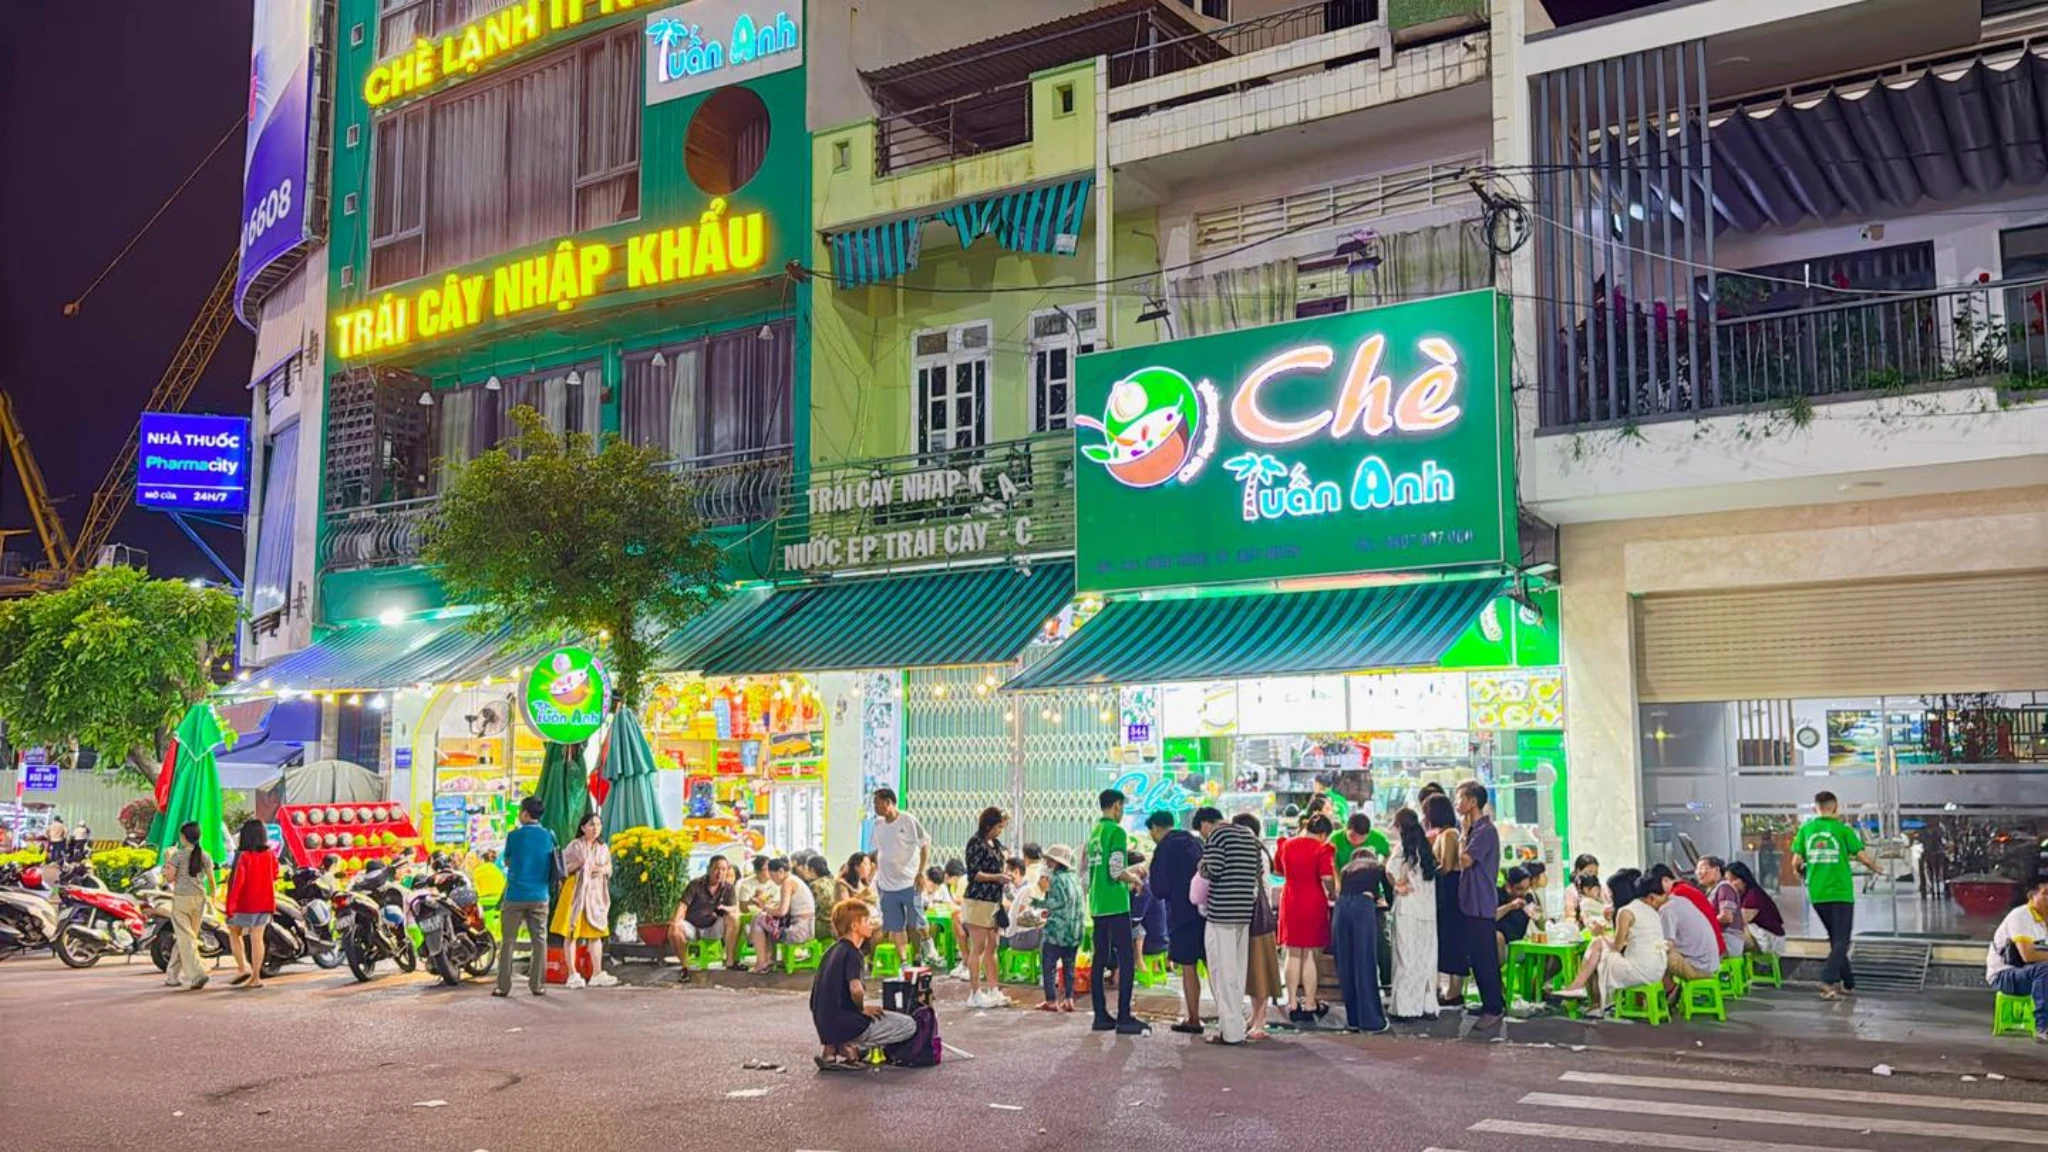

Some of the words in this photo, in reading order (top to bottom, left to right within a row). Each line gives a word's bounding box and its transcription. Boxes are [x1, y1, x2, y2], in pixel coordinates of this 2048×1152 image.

[363, 37, 436, 108] CHÈ
[441, 0, 542, 73] LẠNH
[645, 18, 723, 82] Tuấn
[729, 12, 797, 65] Anh
[335, 292, 408, 359] TRÁI
[417, 273, 485, 337] CÂY
[493, 240, 612, 311] NHẬP
[626, 197, 765, 289] KHẨU
[1231, 334, 1460, 443] Chè
[147, 431, 182, 446] NHÀ
[184, 432, 240, 448] THUỐC
[193, 491, 227, 502] 24H/7
[806, 474, 853, 514] TRÁI
[855, 470, 895, 508] CÂY
[1222, 452, 1342, 521] Tuấn
[1350, 455, 1455, 510] Anh
[784, 532, 842, 571] NƯỚC
[883, 518, 936, 560] TRÁI
[944, 513, 989, 554] CÂY
[571, 708, 601, 725] Anh
